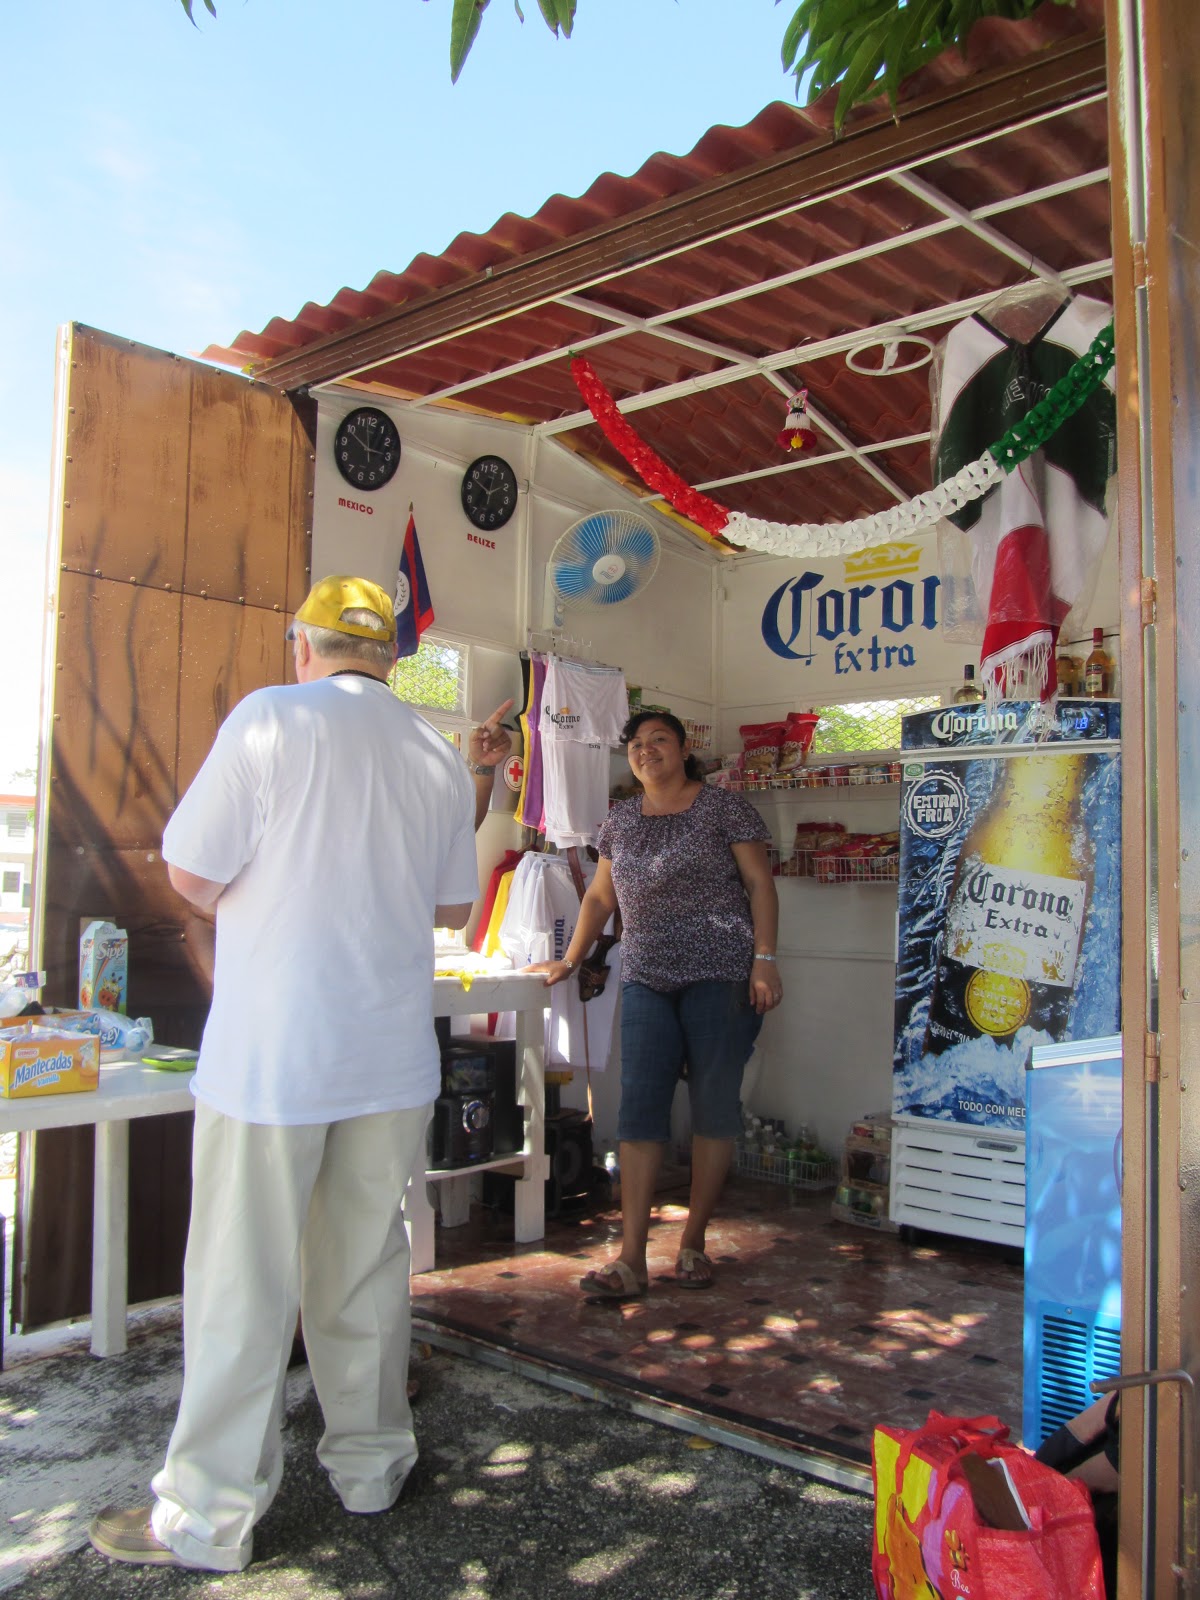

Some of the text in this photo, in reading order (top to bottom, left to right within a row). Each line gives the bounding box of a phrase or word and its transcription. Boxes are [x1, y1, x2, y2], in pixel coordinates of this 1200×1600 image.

[357, 416, 365, 427] 11
[368, 417, 378, 428] 12
[347, 424, 356, 434] 10
[380, 426, 385, 434] 1
[341, 437, 348, 446] 9
[384, 438, 391, 447] 2
[341, 452, 348, 461] 8
[384, 452, 391, 461] 3
[348, 464, 355, 473] 7
[379, 465, 385, 473] 4
[480, 463, 488, 473] 11
[490, 463, 498, 474] 12
[357, 472, 364, 481] 6
[368, 472, 375, 481] 5
[472, 470, 480, 479] 10
[500, 472, 505, 480] 1
[466, 481, 473, 490] 9
[503, 483, 509, 491] 2
[466, 495, 473, 503] 8
[503, 496, 509, 505] 3
[338, 497, 373, 515] MEXICO
[471, 506, 477, 514] 7
[498, 507, 503, 515] 4
[479, 513, 486, 522] 6
[489, 513, 495, 522] 5
[467, 533, 496, 550] BELIZE
[761, 571, 957, 666] Coron
[834, 635, 917, 674] Extra
[931, 710, 1018, 741] Corona
[913, 794, 959, 809] EXTRA
[917, 807, 954, 823] FRIA
[967, 869, 1073, 917] Corona
[985, 908, 1048, 938] Extra
[96, 940, 125, 960] Sipp
[14, 1051, 72, 1088] Mantecadas
[958, 1100, 983, 1113] TODO
[985, 1103, 1005, 1116] CON
[950, 1568, 970, 1594] Bee
